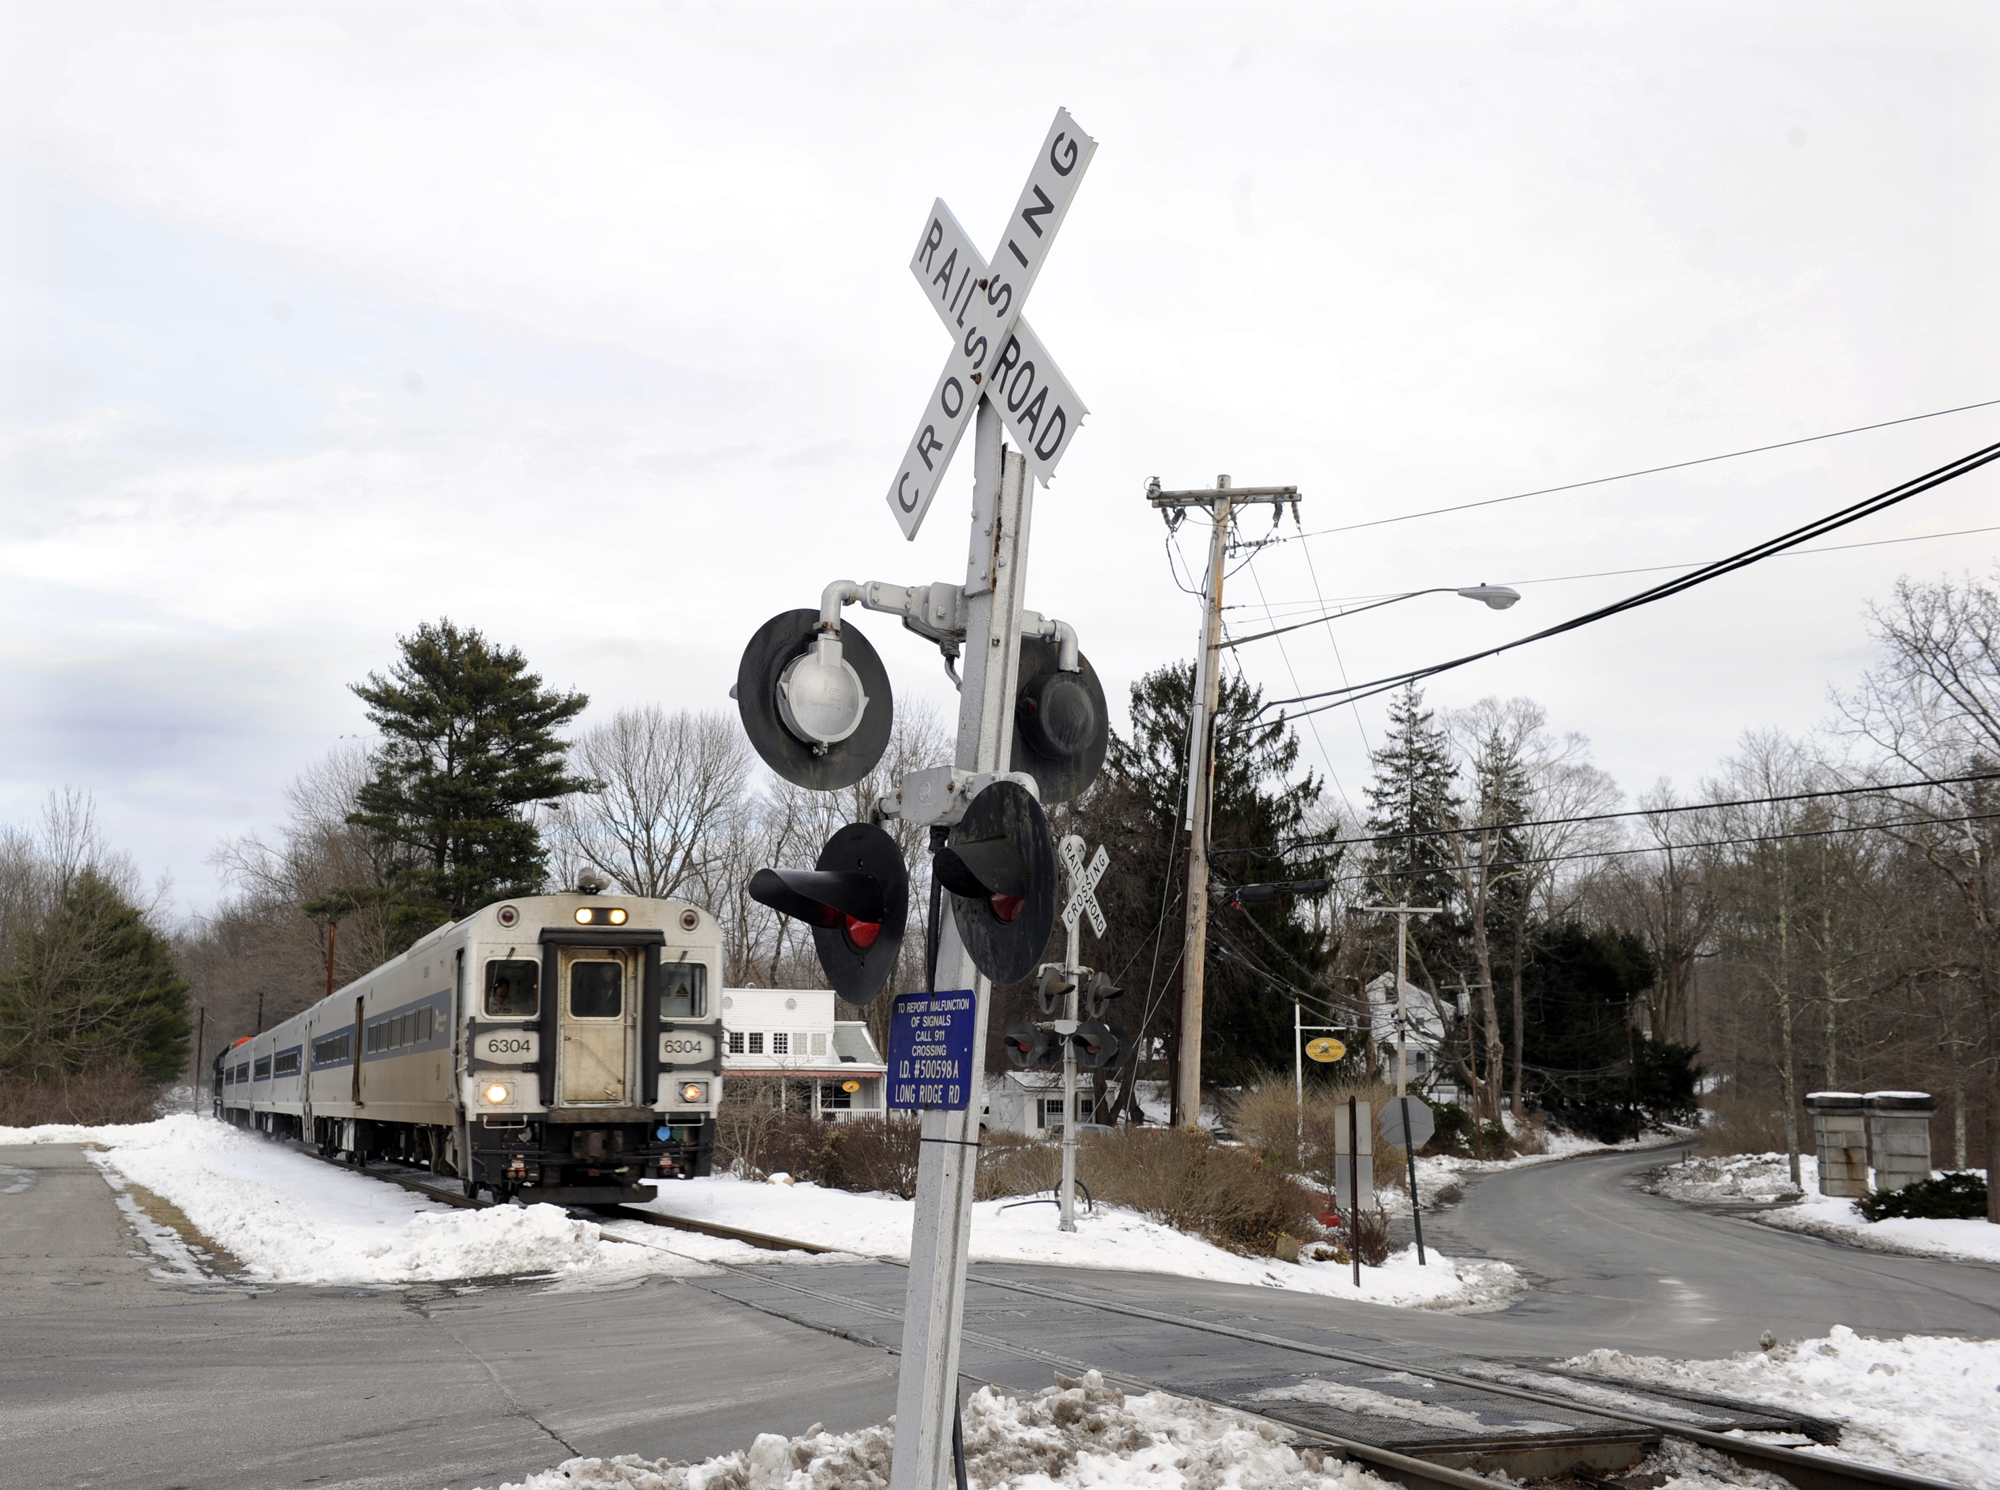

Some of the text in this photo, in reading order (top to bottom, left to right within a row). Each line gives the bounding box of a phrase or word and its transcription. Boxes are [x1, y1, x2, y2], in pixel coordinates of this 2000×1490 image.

[898, 131, 1078, 513] CROSSING
[1066, 854, 1106, 924] CROSSING
[898, 998, 970, 1014] TO REPORT MALFUNCTION
[911, 1014, 952, 1028] OF SIGNALS
[915, 1030, 945, 1042] CALL 911
[488, 1038, 531, 1053] 6304
[664, 1039, 702, 1054] 6304
[911, 1045, 947, 1057] CROSSING
[899, 1060, 911, 1079] I.D.
[895, 1084, 960, 1104] LONG RIDGE RD
